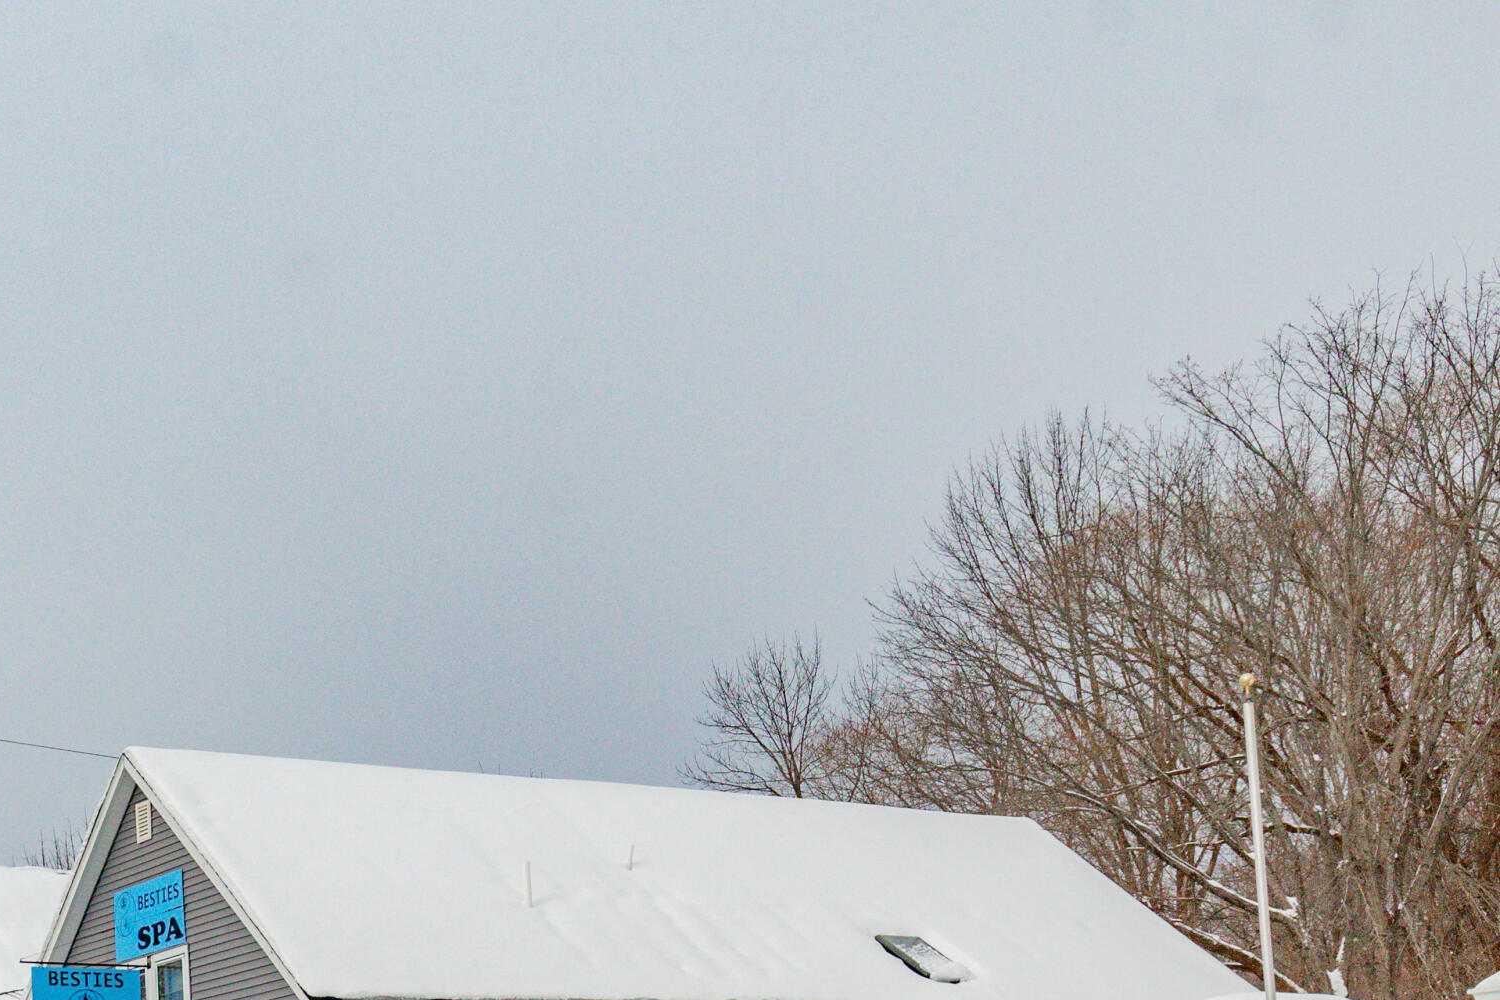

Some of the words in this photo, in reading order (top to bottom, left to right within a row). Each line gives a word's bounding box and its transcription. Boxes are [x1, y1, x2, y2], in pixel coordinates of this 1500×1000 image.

[137, 882, 180, 911] BESTIES
[137, 916, 184, 950] SPA
[48, 970, 124, 988] BESTIES
